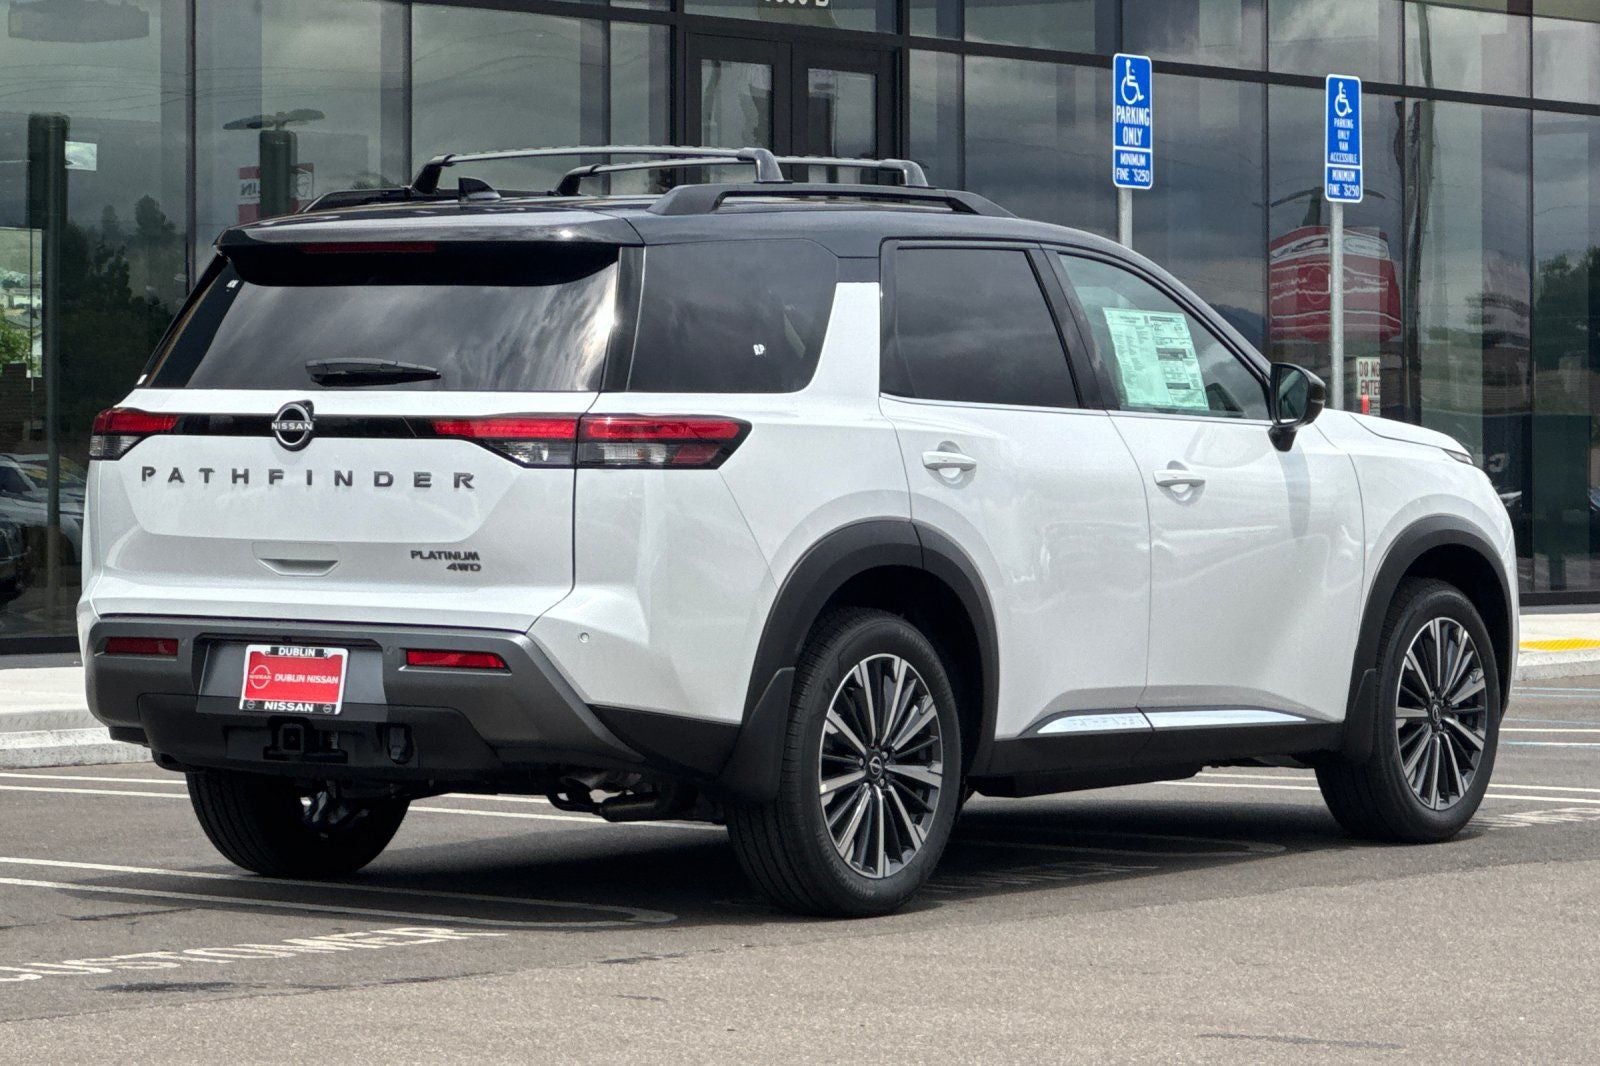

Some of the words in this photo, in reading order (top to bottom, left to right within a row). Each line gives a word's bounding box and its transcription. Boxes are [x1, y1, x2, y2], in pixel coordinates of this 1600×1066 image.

[1116, 106, 1150, 126] PARKING
[1334, 118, 1354, 129] PARKING
[1122, 127, 1143, 145] ONLY
[1337, 129, 1350, 140] ONLY
[1339, 141, 1349, 151] VAN
[1120, 152, 1146, 167] MINIMUM
[1330, 152, 1357, 163] ACCESSIBLE
[1116, 167, 1130, 181] FINE
[1132, 168, 1150, 183] $250
[1331, 169, 1356, 182] MINIMUM
[1328, 183, 1341, 196] FINE
[1342, 183, 1360, 197] $250
[1359, 362, 1368, 376] DO
[1371, 361, 1380, 377] NO
[1361, 380, 1380, 395] ENTE
[271, 421, 314, 432] NISSAN
[141, 466, 475, 489] PATHFINDER
[410, 549, 480, 562] PLATINUM
[446, 562, 482, 573] 4WD
[278, 647, 315, 657] DUBLIN
[274, 673, 305, 683] DUBLIN
[306, 675, 339, 684] NISSAN
[264, 701, 314, 713] NISSAN
